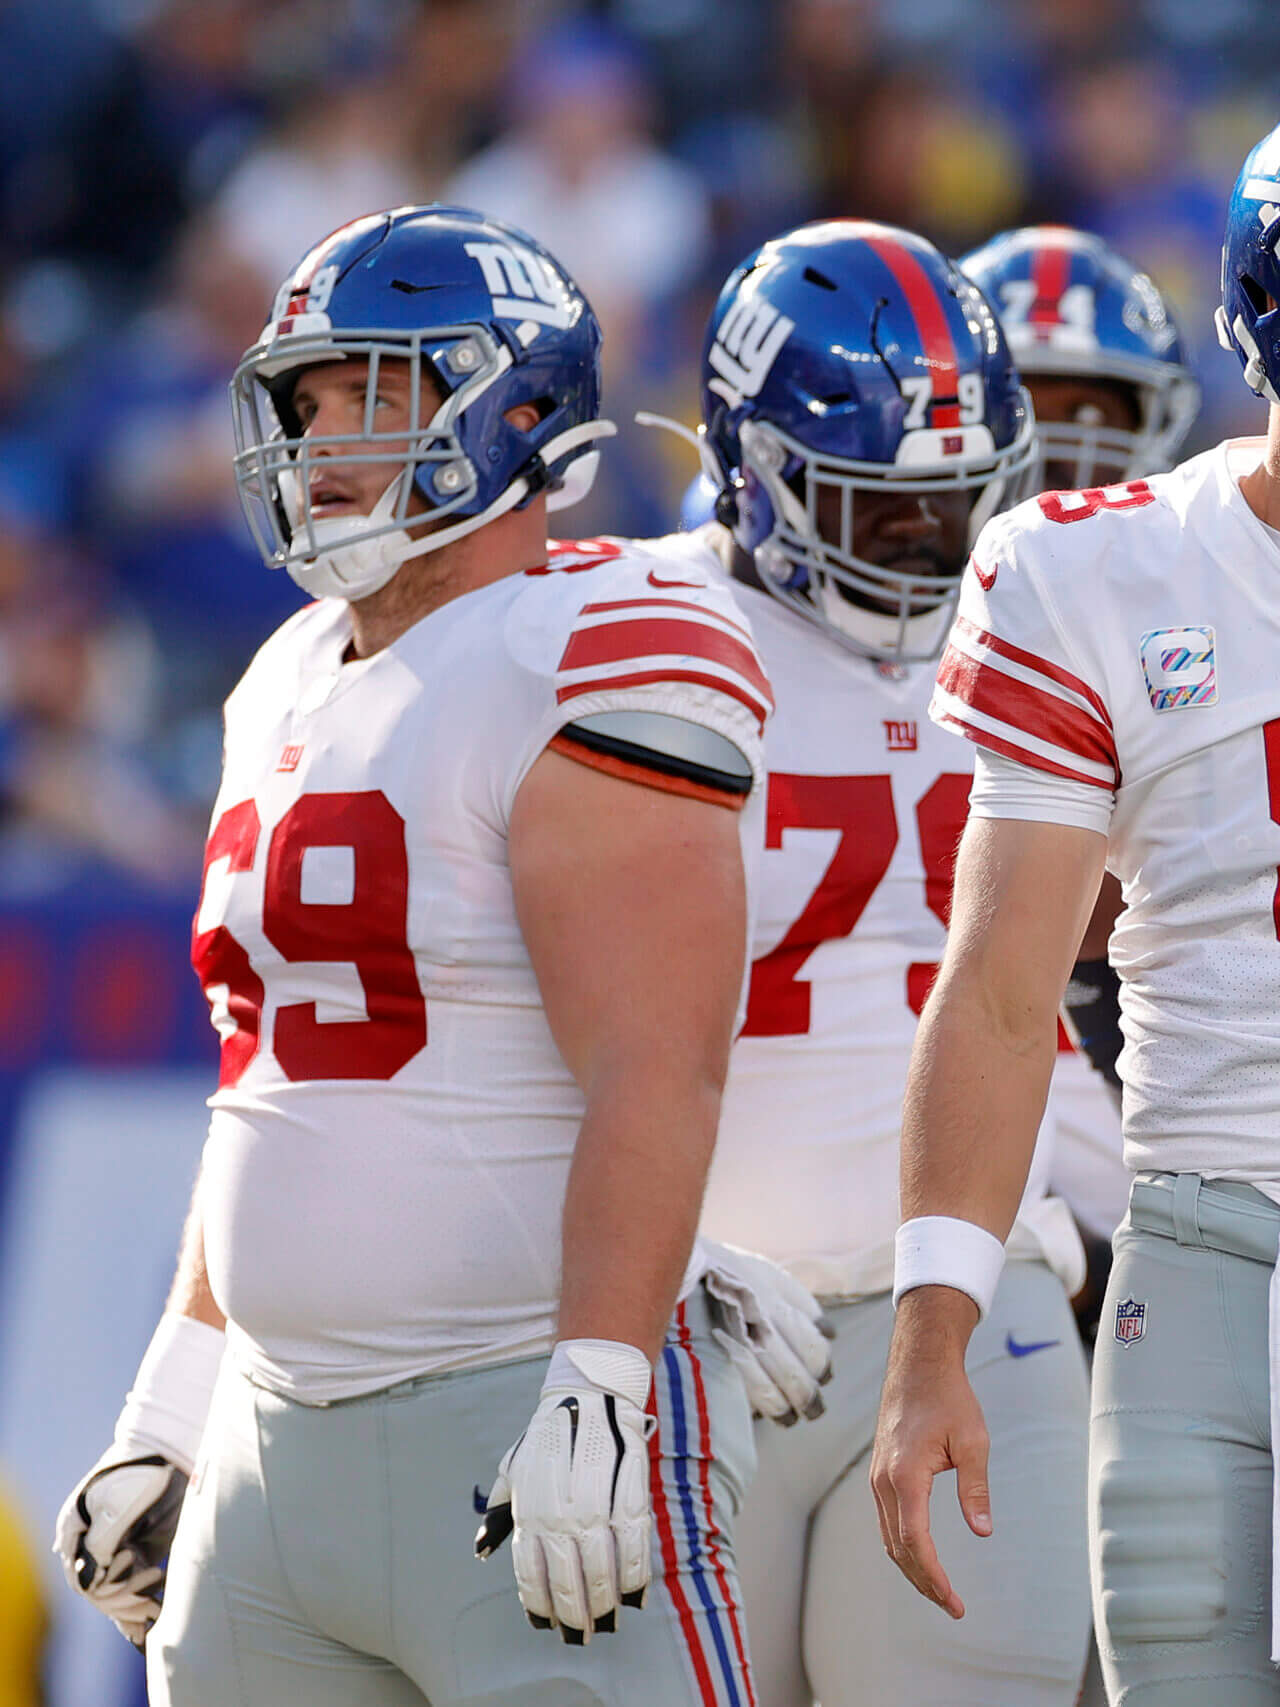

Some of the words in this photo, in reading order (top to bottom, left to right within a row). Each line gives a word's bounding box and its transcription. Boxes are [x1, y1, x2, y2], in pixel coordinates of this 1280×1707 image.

[901, 372, 985, 430] 79
[1141, 631, 1213, 690] C
[191, 788, 428, 1088] 69
[1119, 1319, 1141, 1338] NFL
